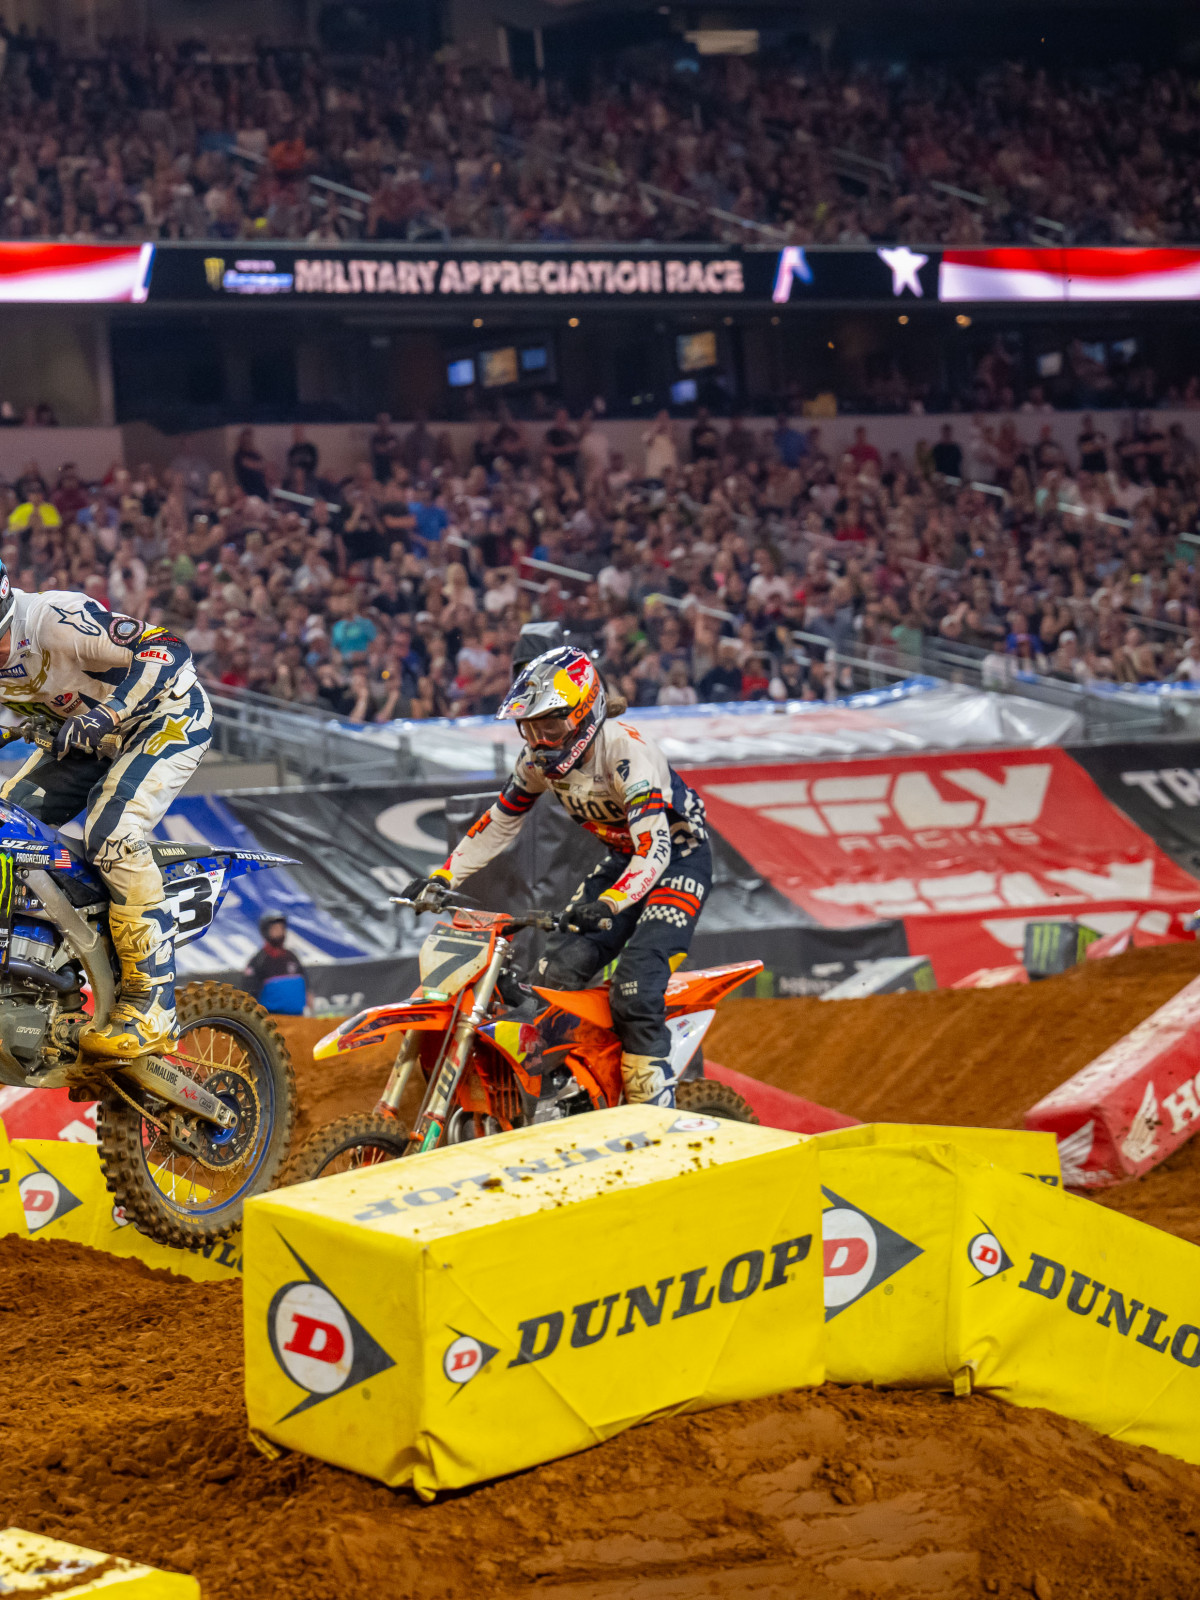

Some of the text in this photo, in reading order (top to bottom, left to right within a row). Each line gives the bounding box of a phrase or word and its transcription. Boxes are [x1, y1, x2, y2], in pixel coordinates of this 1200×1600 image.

[294, 258, 439, 294] MILITARY
[440, 259, 662, 294] APPRECIATION
[665, 259, 744, 294] RACE
[140, 650, 169, 662] BELL
[574, 682, 601, 720] OAKLEY
[810, 764, 1053, 836] FLY
[1121, 767, 1200, 810] TR
[0, 839, 28, 849] YZ
[15, 852, 50, 864] PROGRESSIVE
[158, 847, 187, 856] YAMAHA
[837, 827, 1041, 854] RACING
[164, 877, 214, 933] 3
[421, 940, 485, 988] 7
[619, 981, 638, 990] SINCE
[146, 1059, 179, 1086] YAMALUBE
[353, 1130, 662, 1222] DUNLOP
[823, 1237, 869, 1277] D
[975, 1244, 999, 1266] D
[506, 1233, 814, 1370] DUNLOP
[283, 1313, 346, 1365] D
[450, 1348, 479, 1372] D
